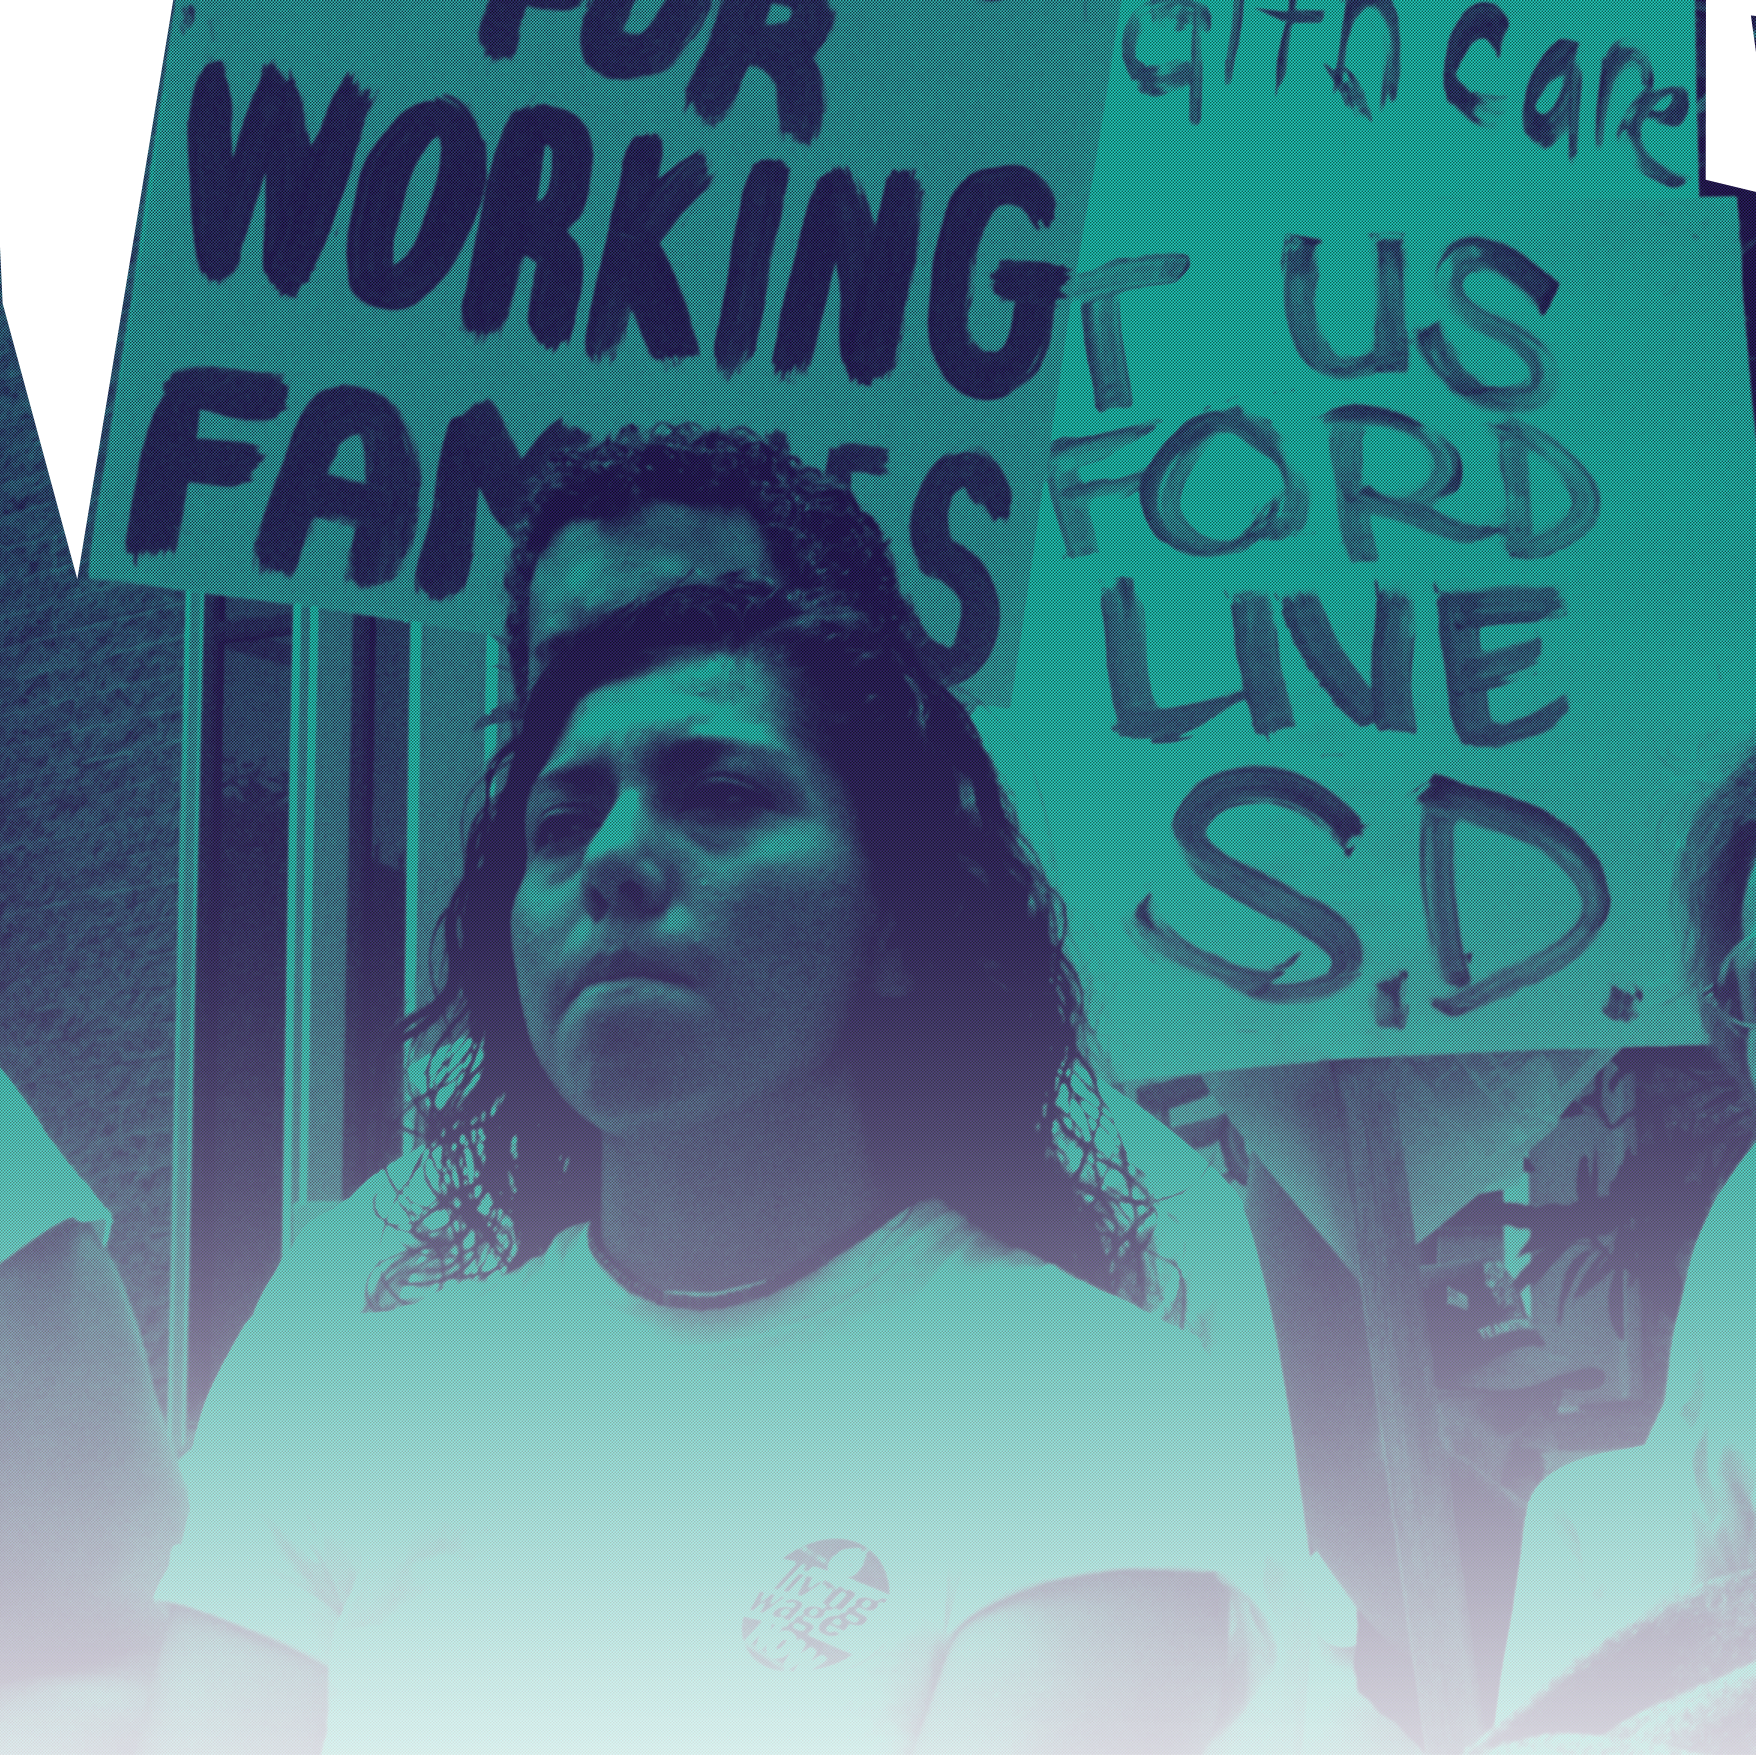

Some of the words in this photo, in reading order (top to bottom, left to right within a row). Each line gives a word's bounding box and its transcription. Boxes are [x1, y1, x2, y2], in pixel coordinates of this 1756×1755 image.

[1442, 1, 1691, 189] care
[185, 59, 1072, 402] WORKING
[1280, 232, 1560, 412] US
[1047, 403, 1602, 561] FORD
[1100, 575, 1570, 748] LIVE
[1125, 764, 1644, 1030] S.D.
